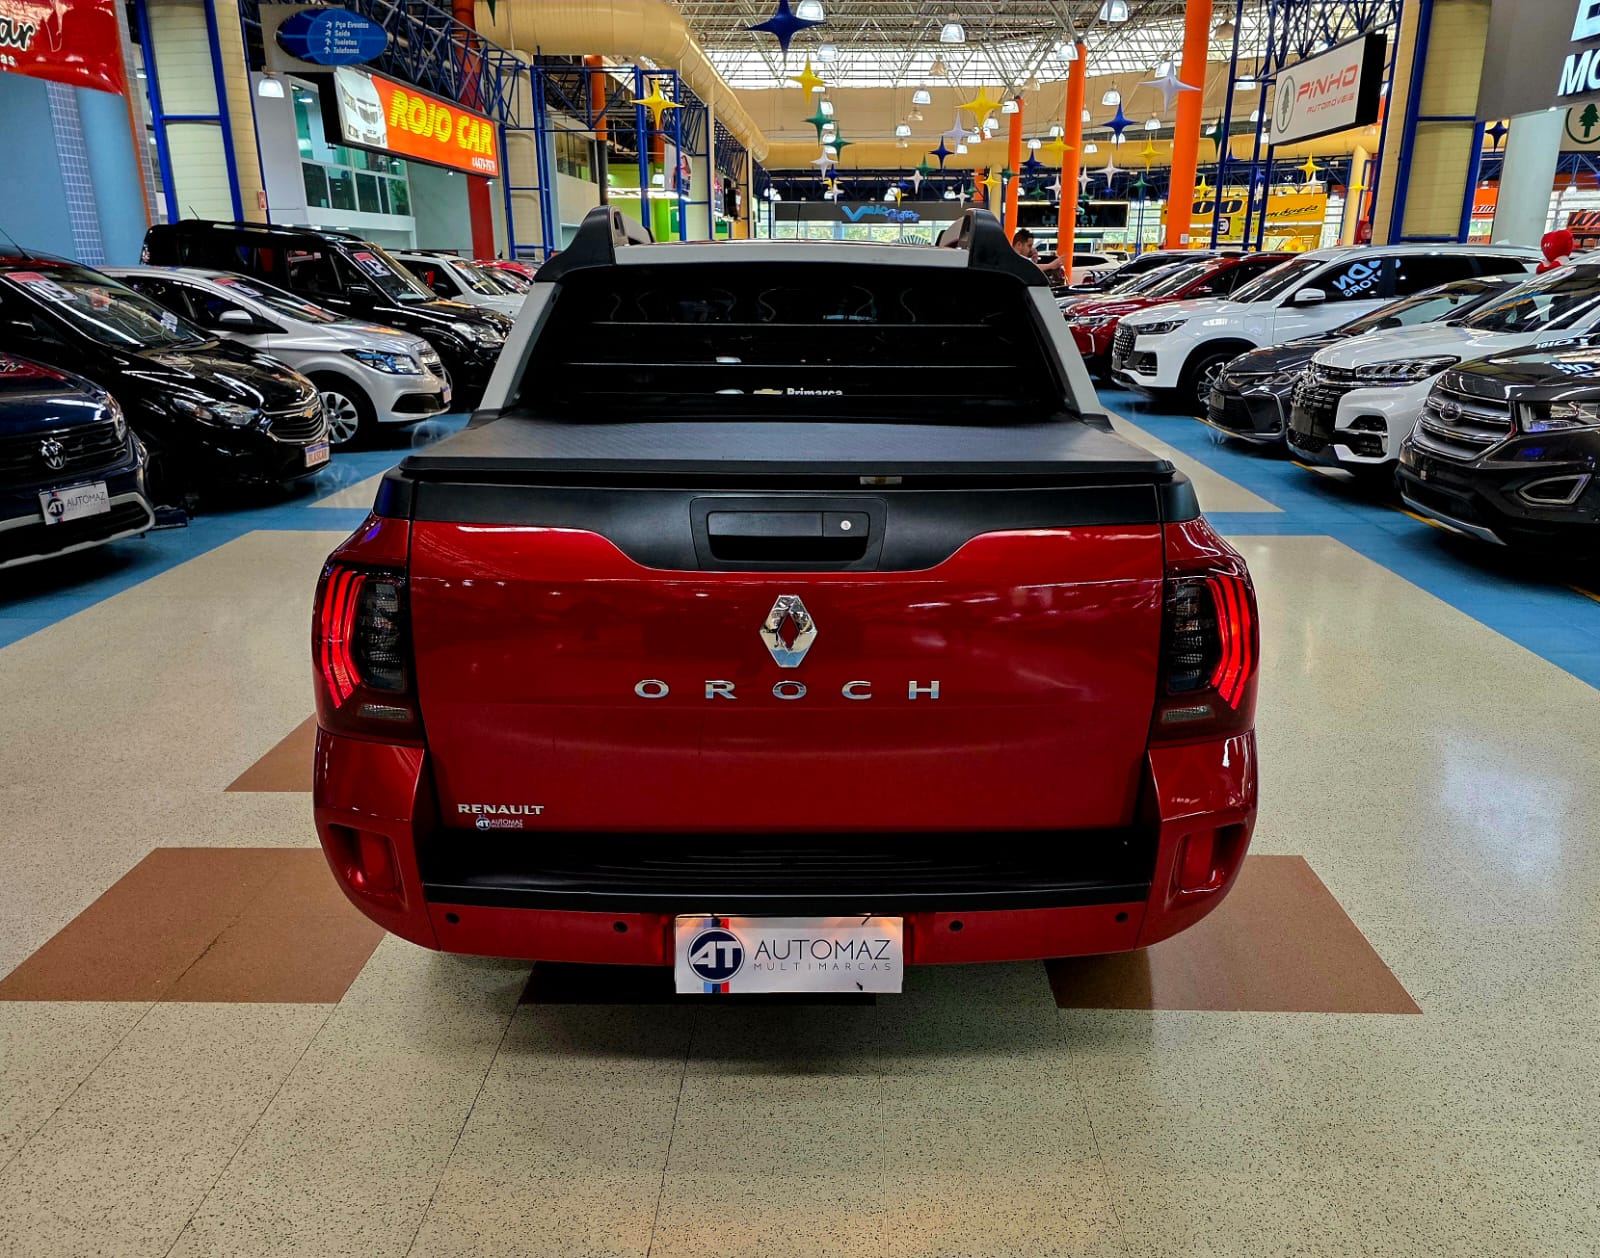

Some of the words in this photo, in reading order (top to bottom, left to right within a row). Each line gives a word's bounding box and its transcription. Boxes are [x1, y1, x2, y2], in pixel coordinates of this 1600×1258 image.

[1297, 64, 1358, 103] PINHO
[389, 89, 453, 143] ROJO
[456, 115, 493, 156] CAR
[66, 491, 106, 508] AUTOMAZ
[634, 679, 940, 700] OROCH
[457, 803, 544, 815] RENAULT
[754, 939, 891, 961] AUTOMAZ
[753, 962, 892, 971] MULTIMARCAS
